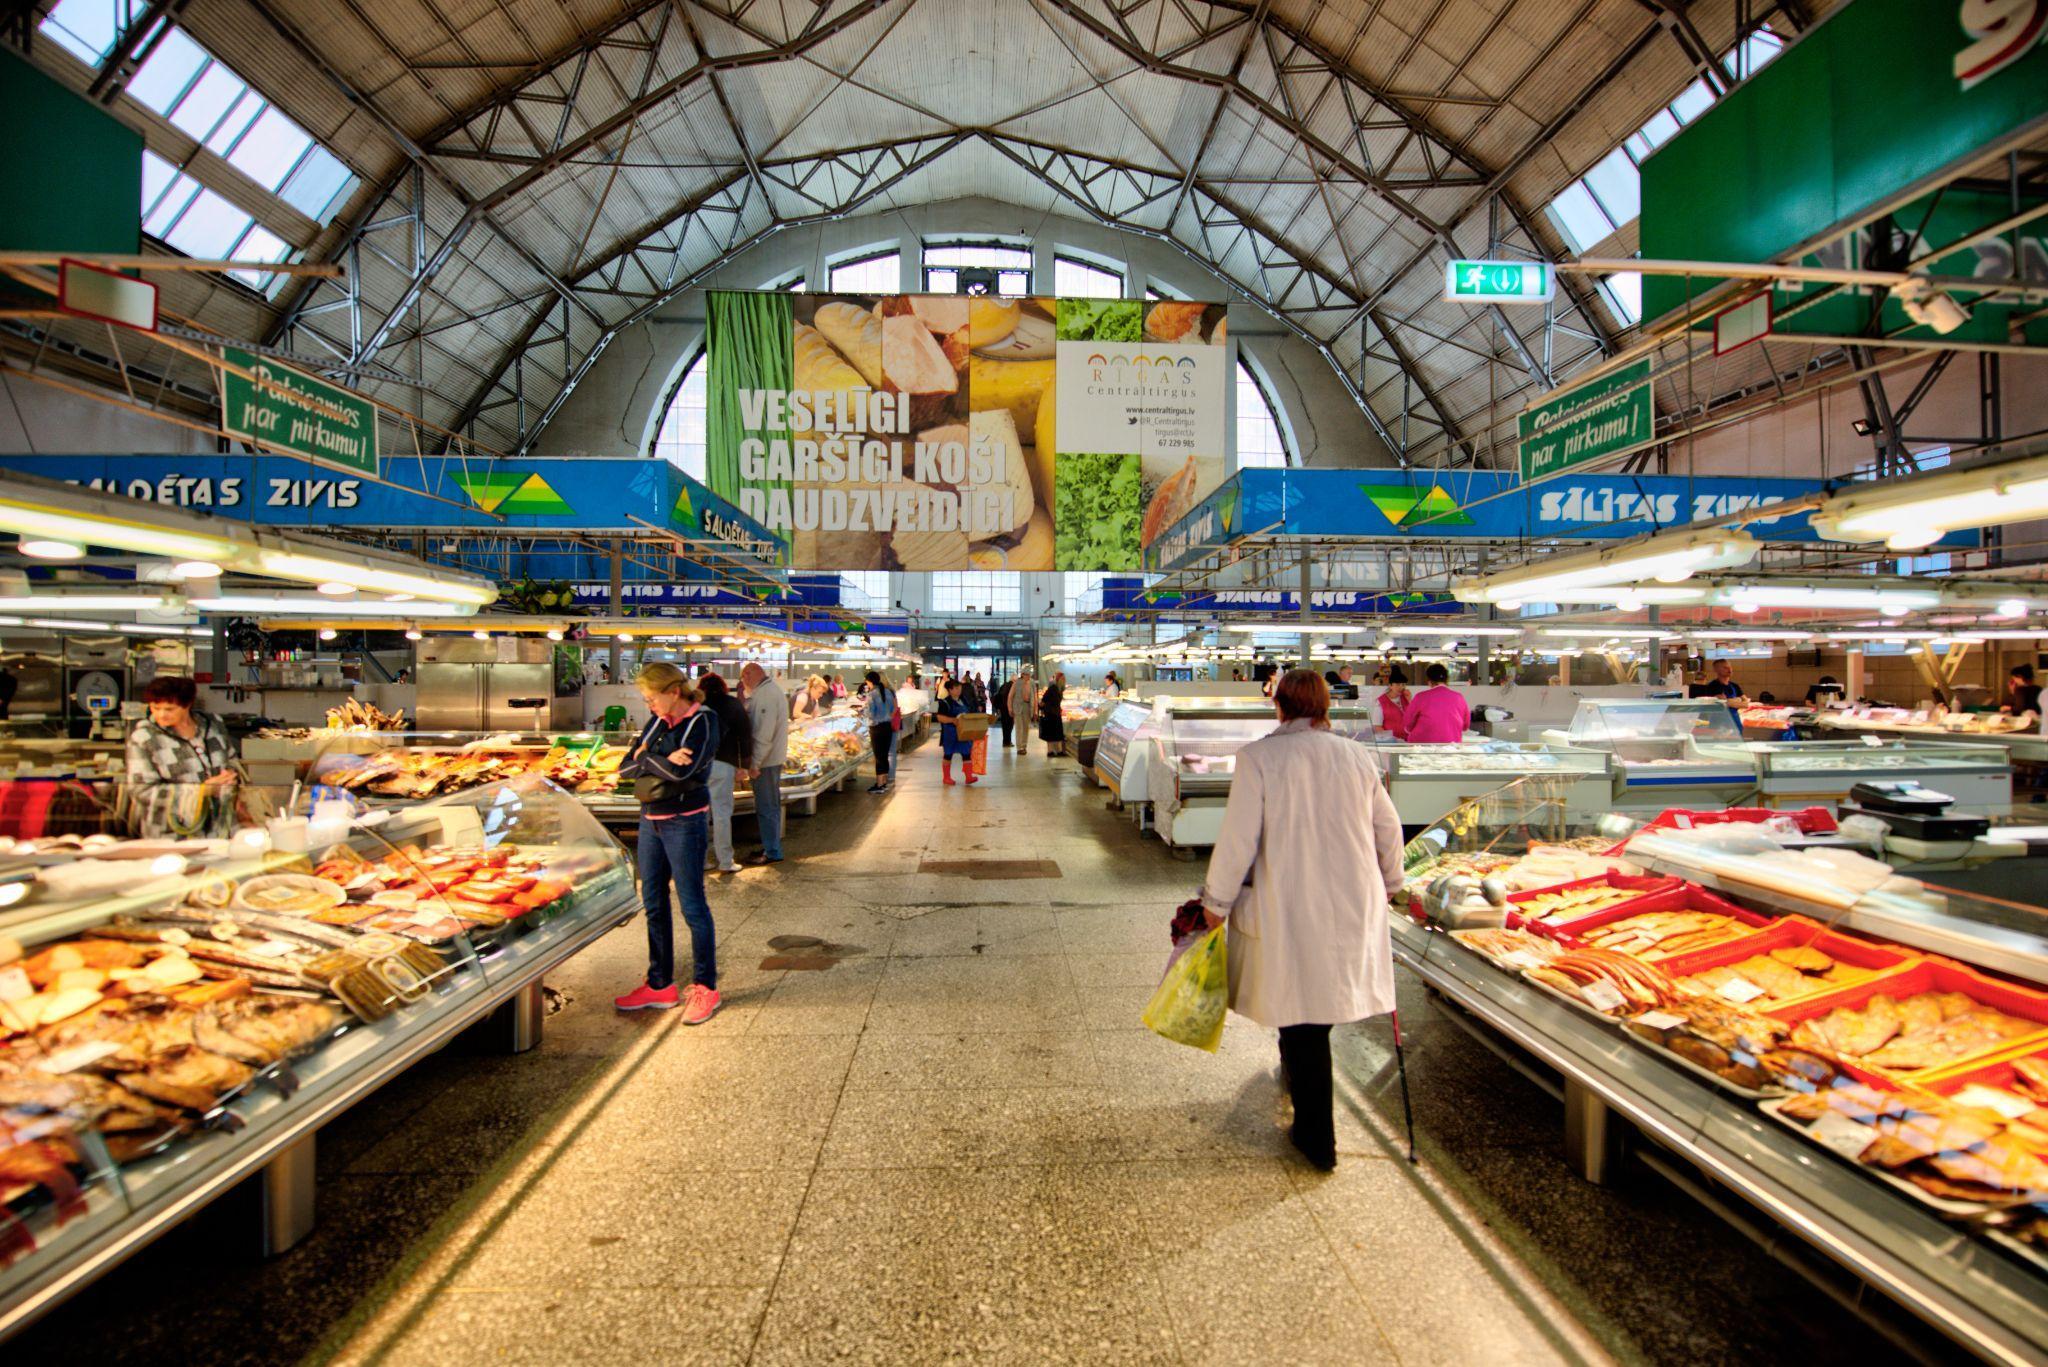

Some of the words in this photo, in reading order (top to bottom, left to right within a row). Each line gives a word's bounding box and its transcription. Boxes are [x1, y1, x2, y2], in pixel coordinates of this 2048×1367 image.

[243, 403, 281, 430] par
[739, 386, 911, 434] VESELĪGI
[739, 432, 903, 483] GARŠĪGI
[914, 434, 1006, 485] KOŠI
[1531, 443, 1557, 475] par
[267, 478, 360, 508] ZIVIS
[739, 486, 1015, 532] DAUDZVEIDĪGI
